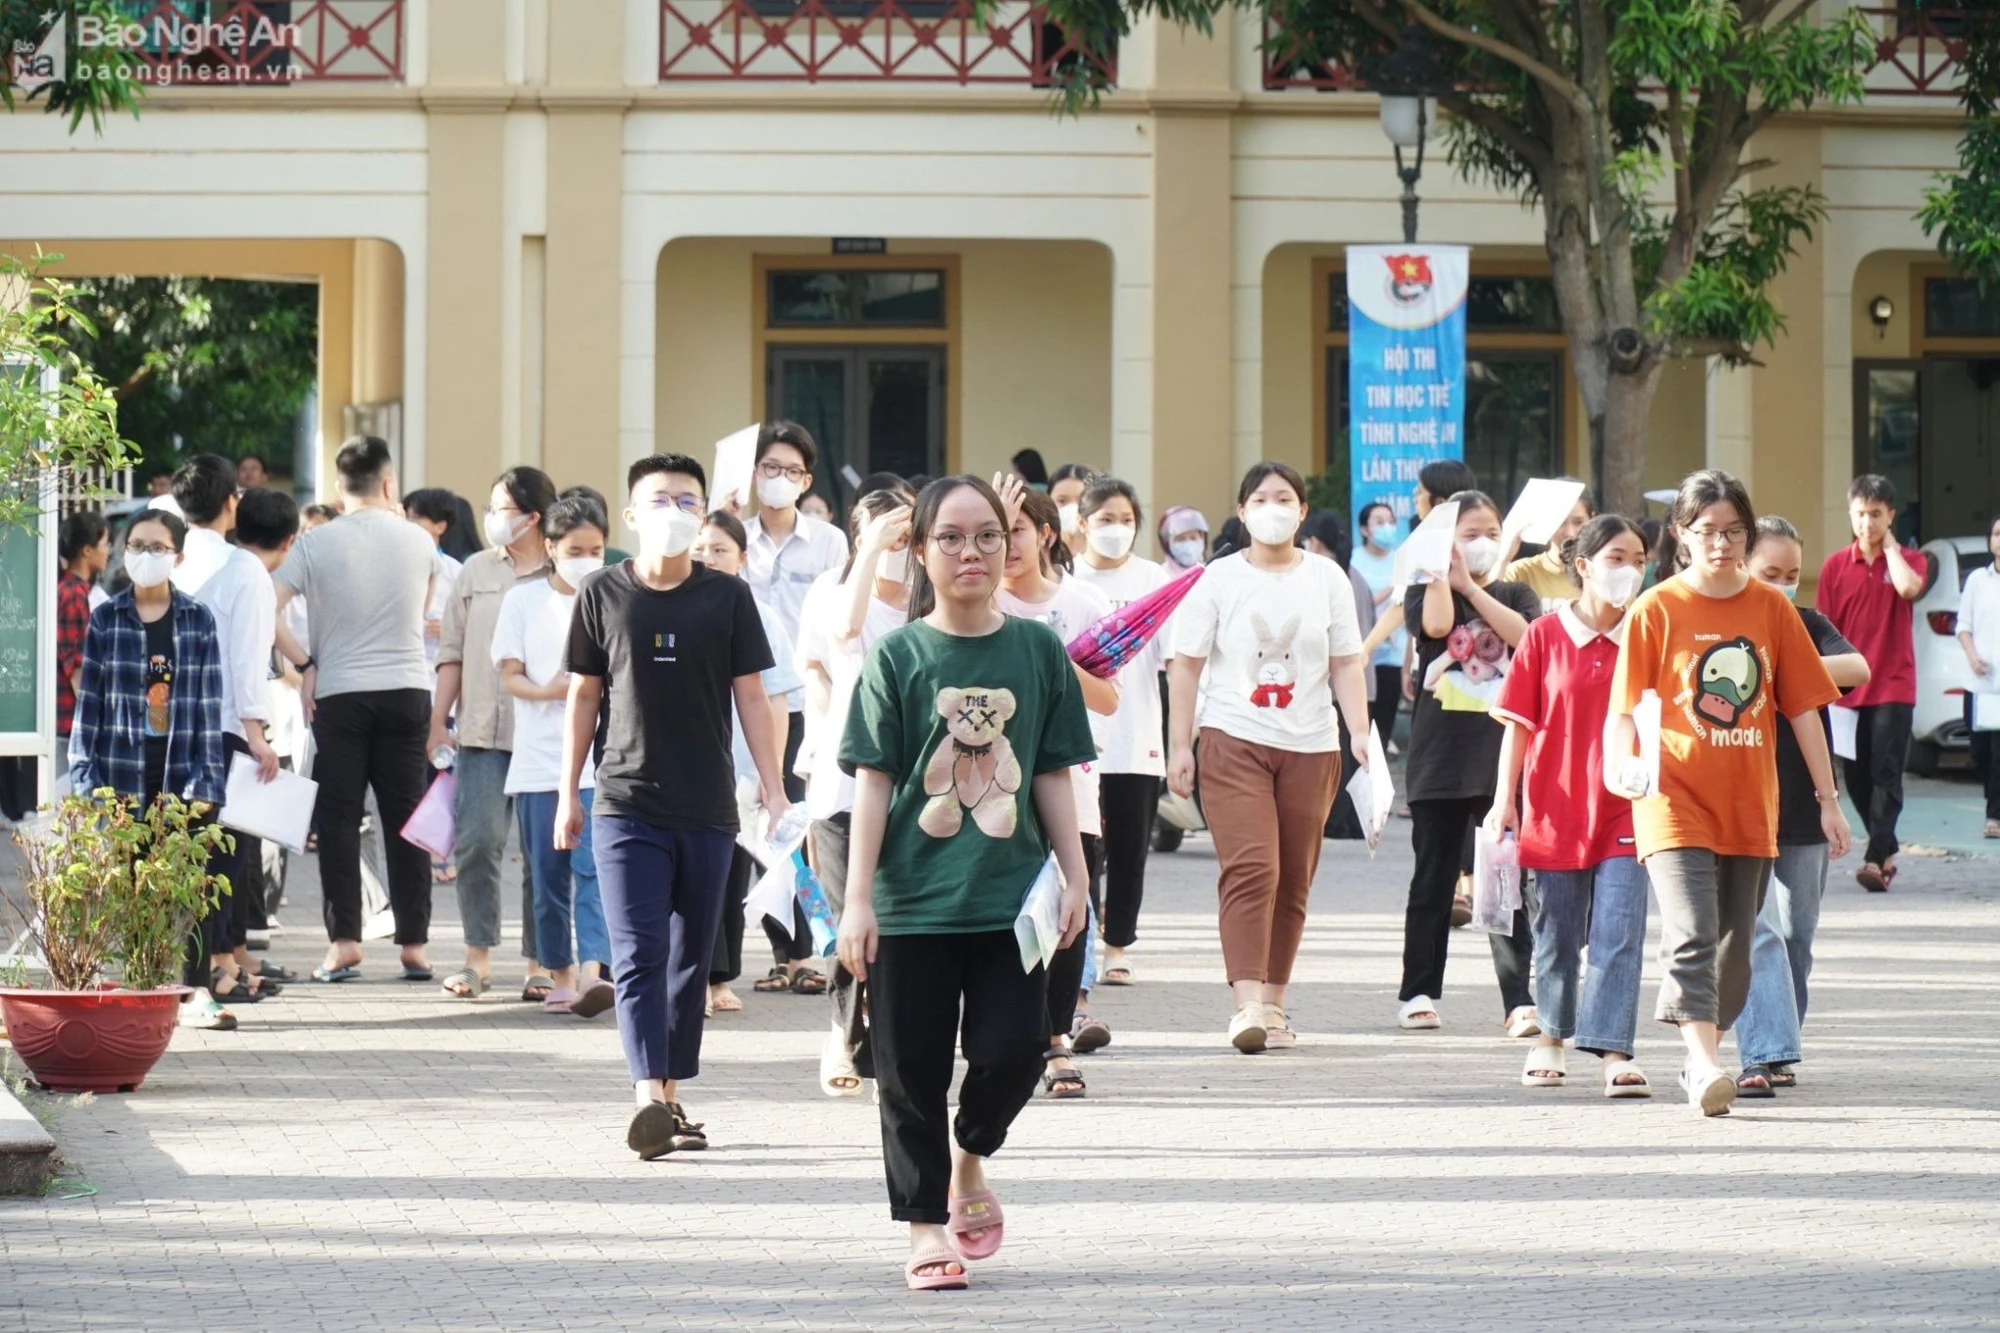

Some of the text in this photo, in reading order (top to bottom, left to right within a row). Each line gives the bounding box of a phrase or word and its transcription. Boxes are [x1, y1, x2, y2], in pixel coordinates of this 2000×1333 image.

[1384, 343, 1436, 375] HỘI THI
[1366, 384, 1391, 409] TIN
[1394, 384, 1425, 413] HỌC
[1360, 415, 1394, 445] TỈNH
[1398, 416, 1438, 449] NGHỆ
[1694, 633, 1722, 641] human
[965, 695, 988, 707] THE
[1711, 727, 1763, 747] made
